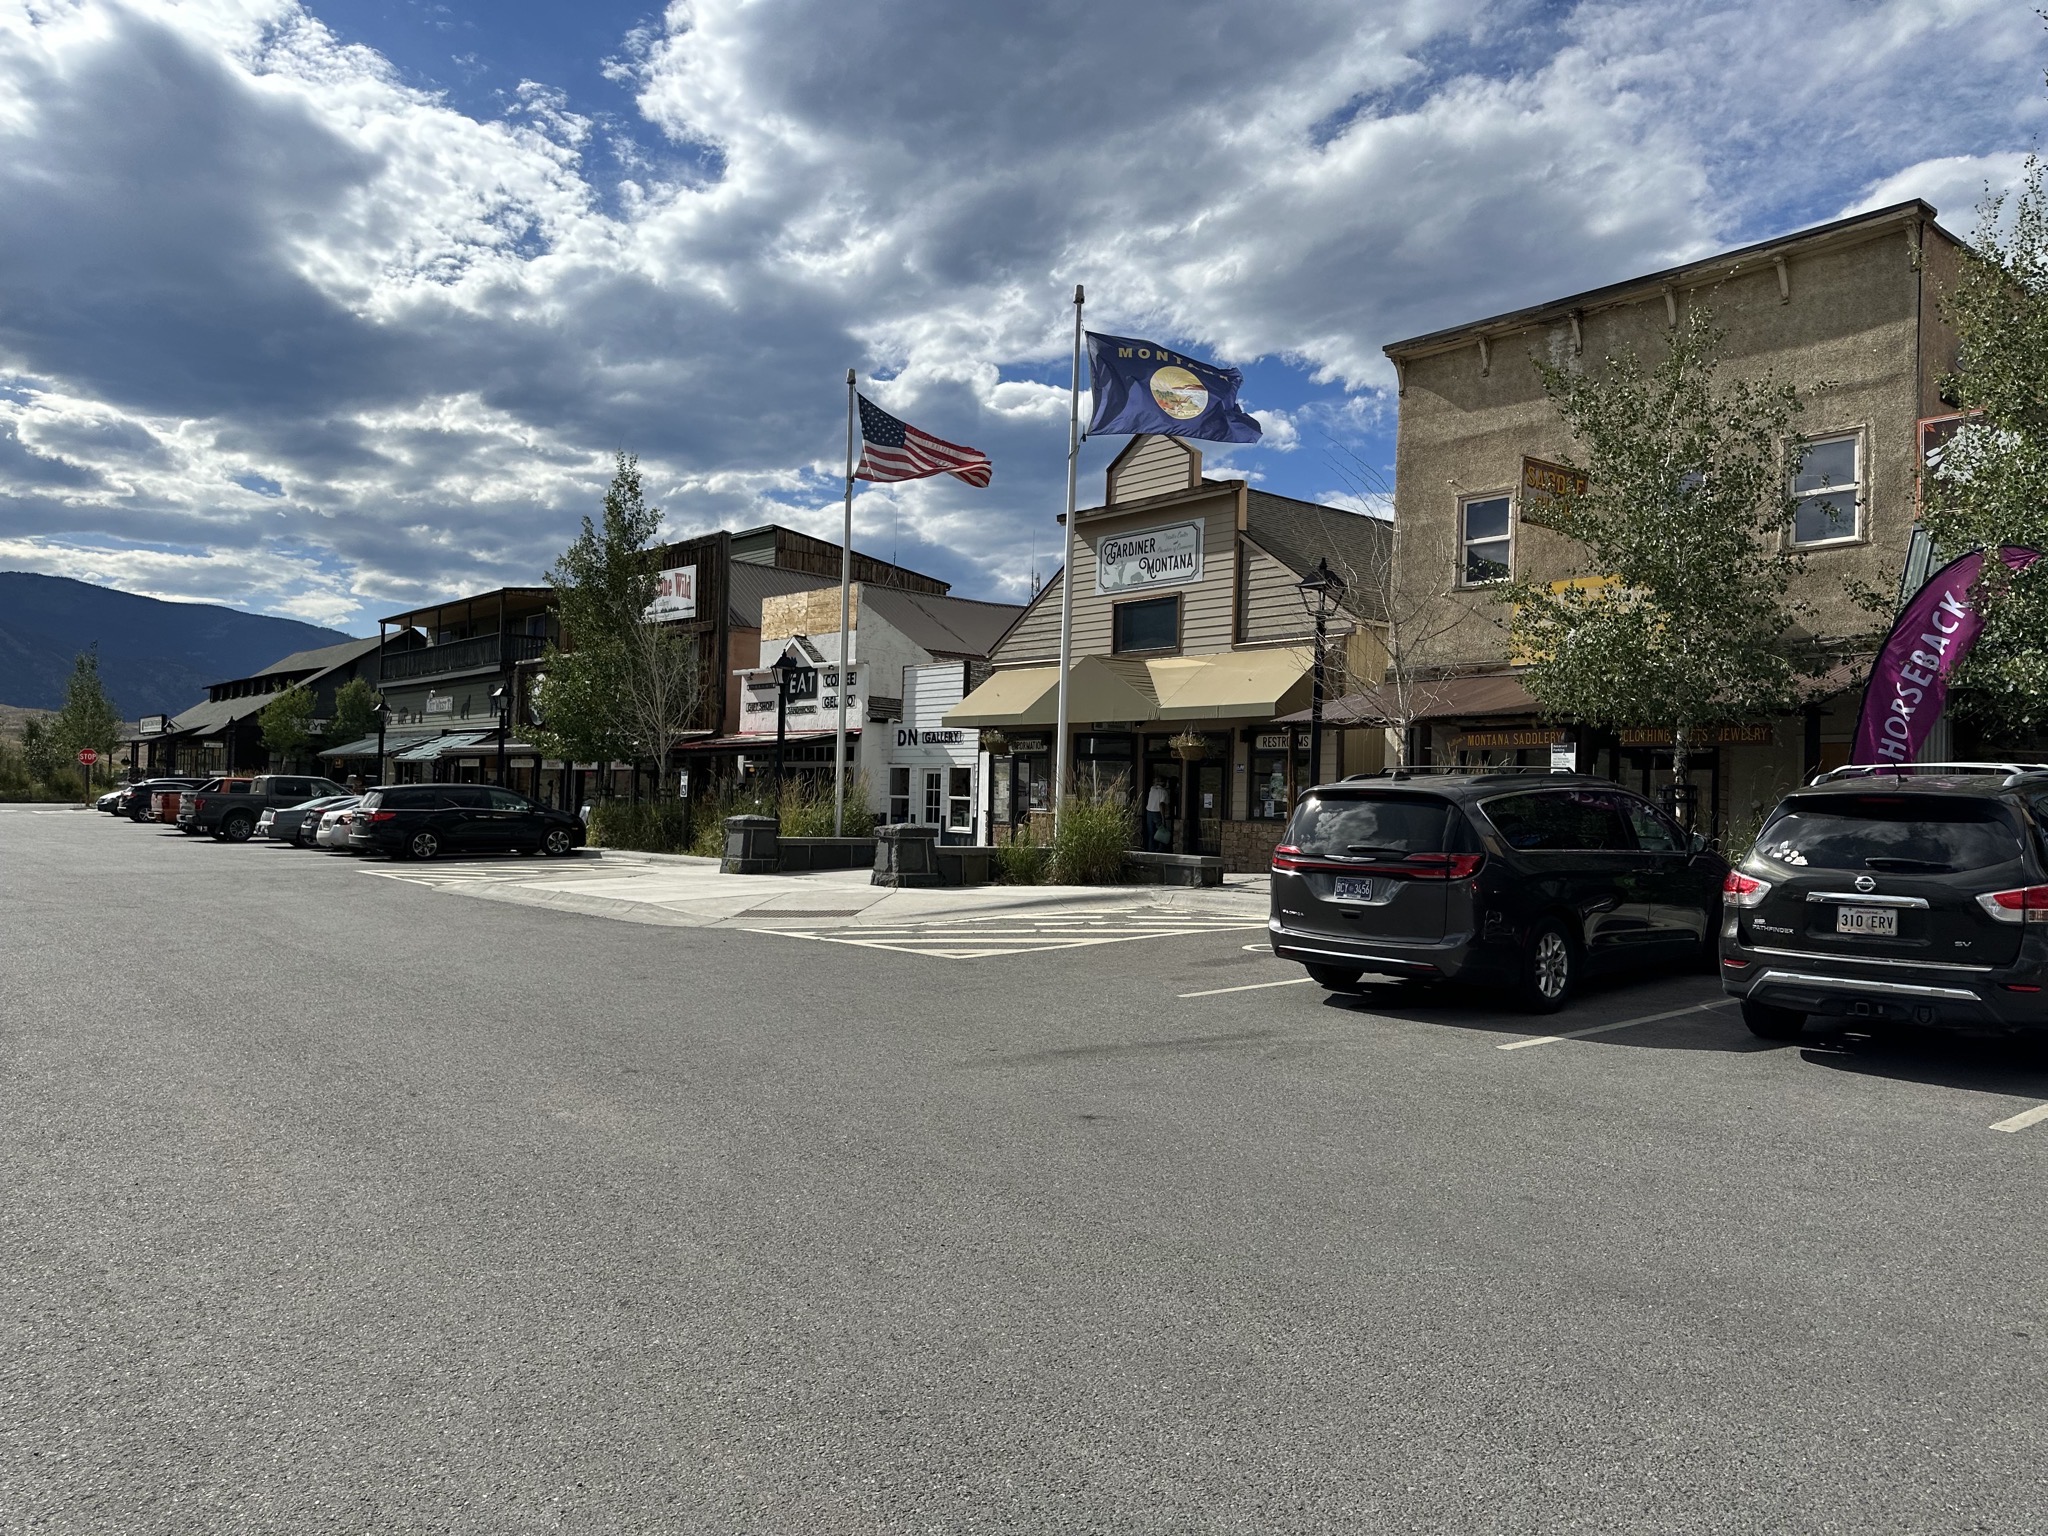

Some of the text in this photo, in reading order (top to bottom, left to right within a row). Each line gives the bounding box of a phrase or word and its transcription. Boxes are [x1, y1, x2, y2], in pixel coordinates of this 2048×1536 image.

[1527, 466, 1584, 496] SADDE
[1104, 538, 1156, 565] GARDINER
[1139, 553, 1193, 579] MONTANA
[675, 573, 692, 599] Wild
[789, 672, 815, 694] EAT
[825, 673, 855, 686] COEE
[1878, 590, 1968, 761] HORSEBACK
[759, 702, 773, 711] SHOP
[824, 696, 853, 708] GELO
[898, 729, 959, 746] DN GALLERY
[1262, 736, 1309, 748] RESTRMS
[1467, 734, 1509, 746] MONTANA
[1513, 731, 1563, 745] SADDLERY
[1718, 727, 1768, 742] JEWELRY
[1353, 883, 1370, 895] 3456
[1752, 924, 1795, 934] PATHFINDER
[1841, 914, 1894, 929] 310 ERV
